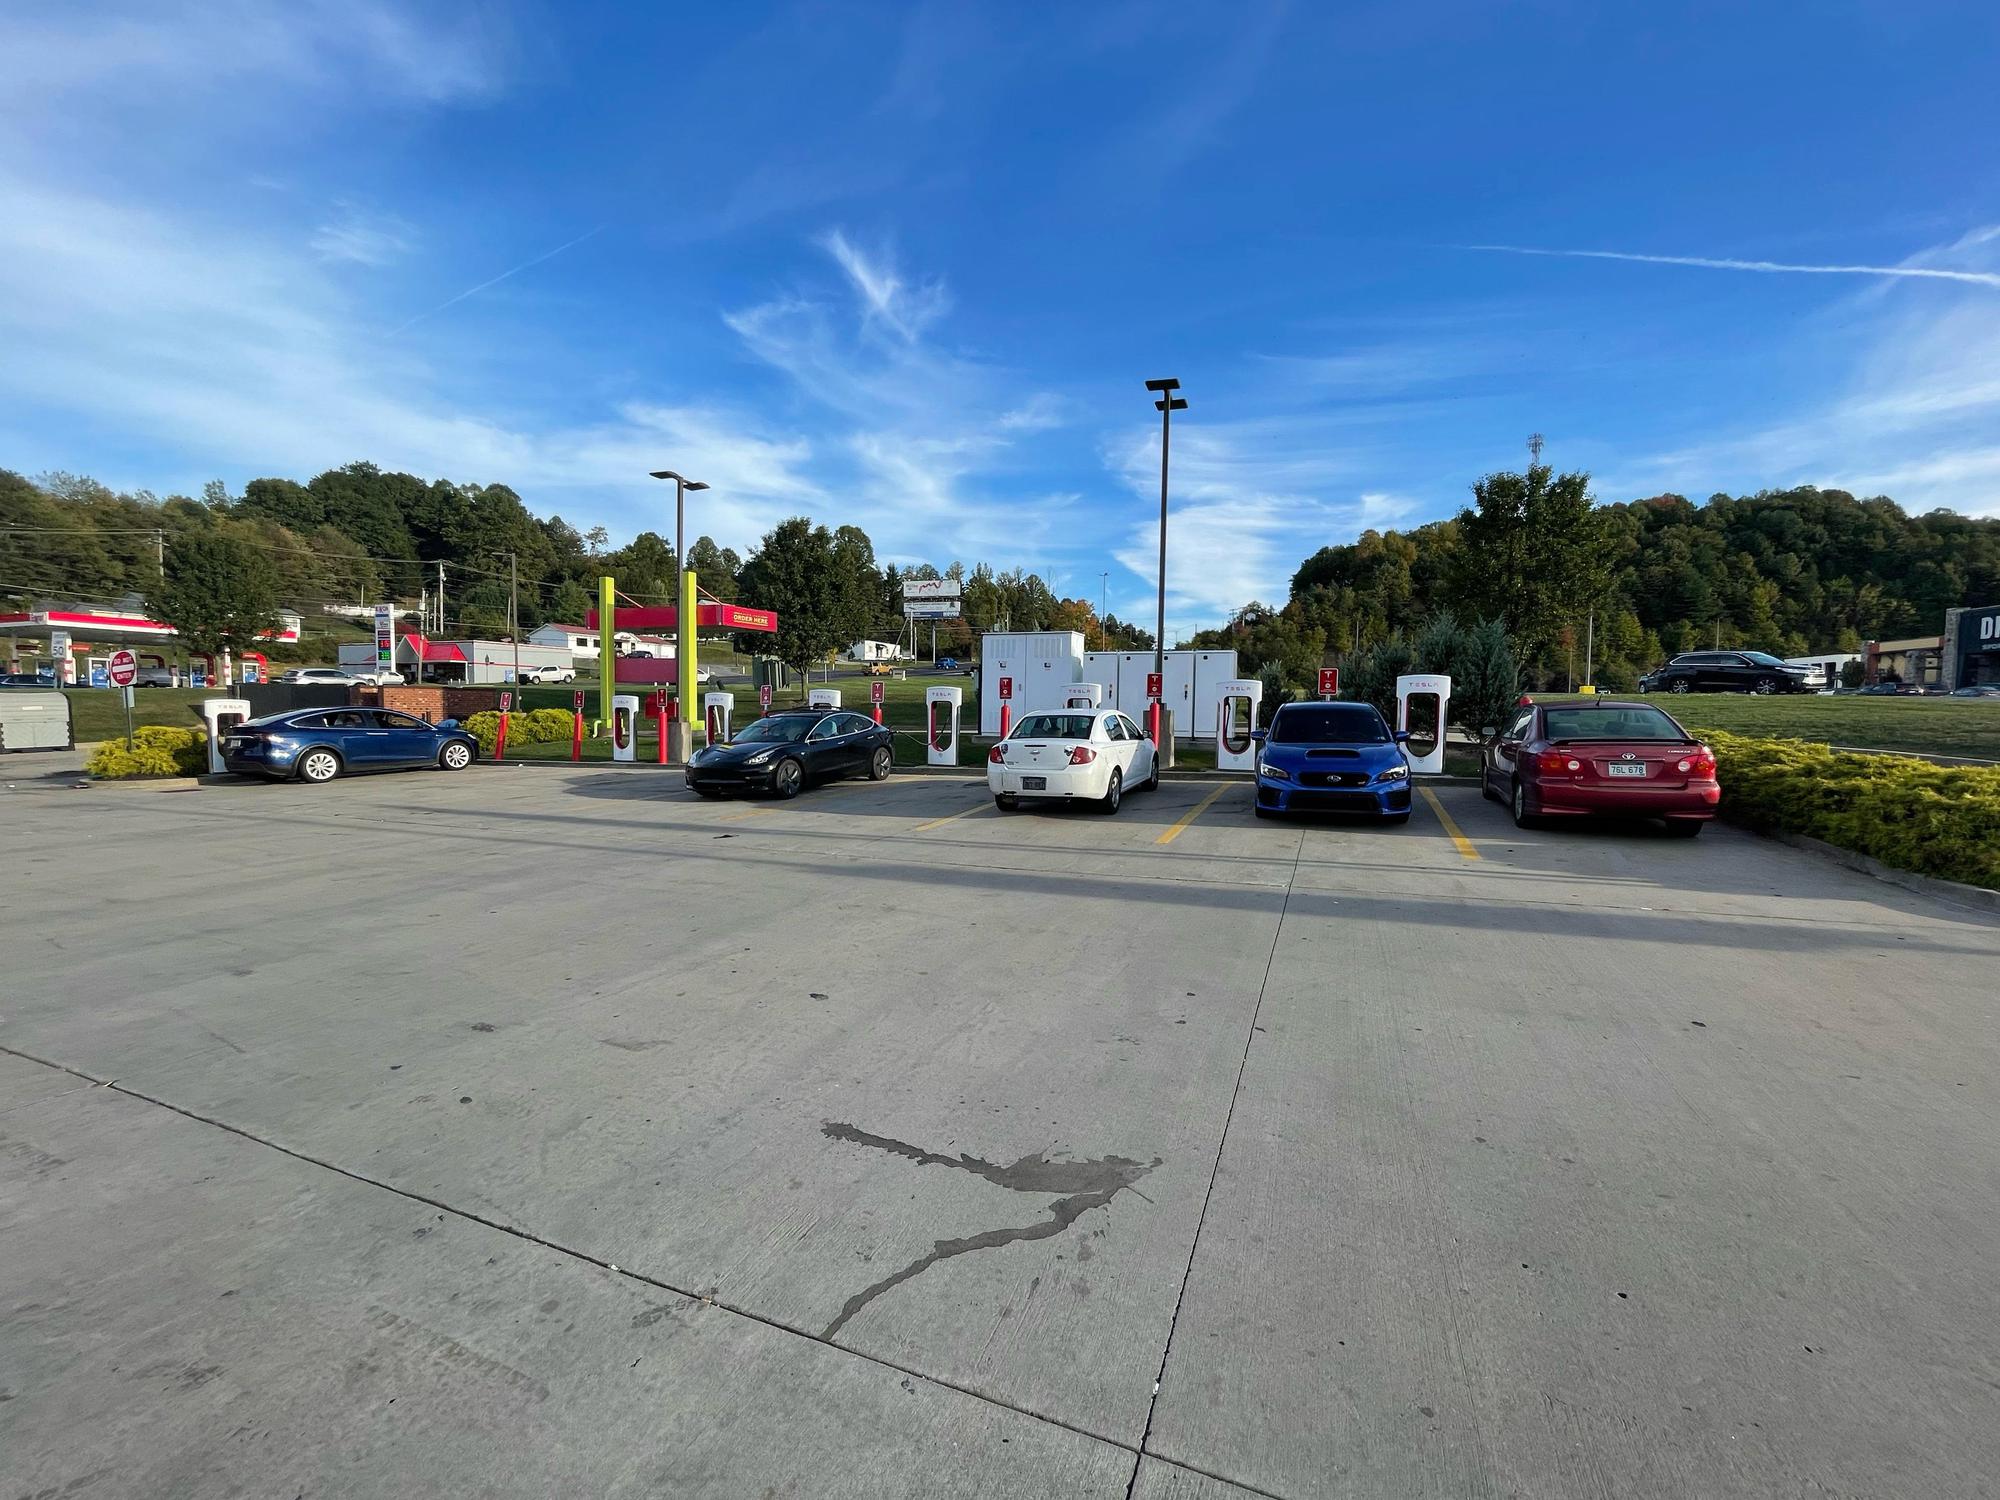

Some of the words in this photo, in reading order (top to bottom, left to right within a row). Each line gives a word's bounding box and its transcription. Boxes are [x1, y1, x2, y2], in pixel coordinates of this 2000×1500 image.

[733, 614, 753, 622] ORDER
[753, 617, 769, 625] HERE
[53, 646, 64, 656] 50
[116, 672, 132, 680] ENTER
[1628, 766, 1644, 774] 678
